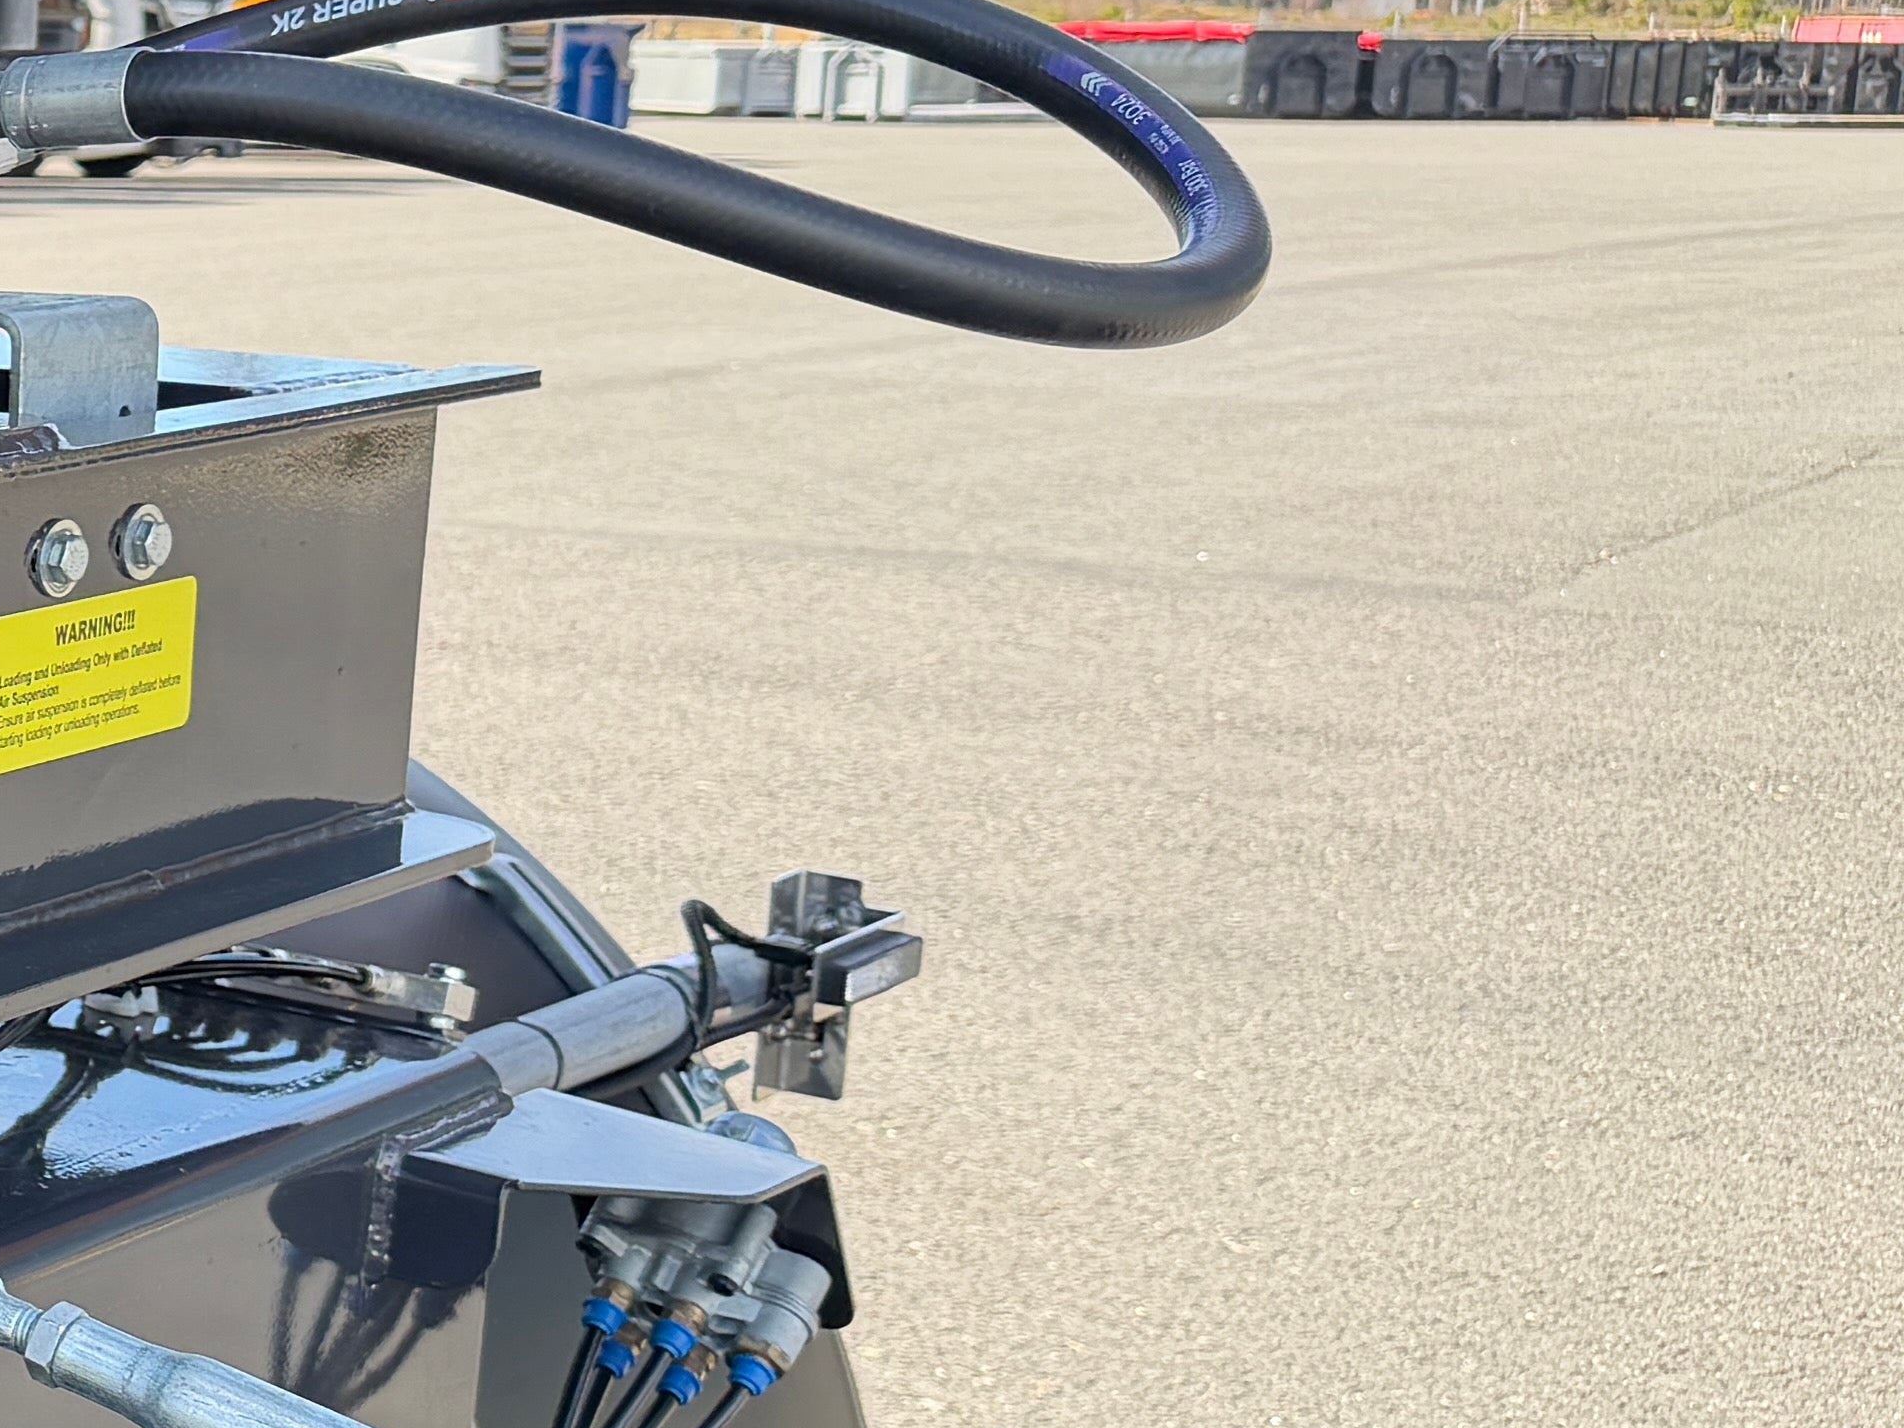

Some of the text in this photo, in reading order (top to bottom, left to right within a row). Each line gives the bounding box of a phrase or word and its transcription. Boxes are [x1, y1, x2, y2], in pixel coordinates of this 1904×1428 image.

[266, 4, 309, 36] 2K
[55, 609, 136, 646] WARNING!!!
[34, 665, 49, 681] and
[51, 657, 91, 677] Unloading
[93, 652, 112, 668] Only
[113, 647, 130, 662] with
[131, 638, 163, 658] Deflated
[12, 684, 60, 706] Suspension
[25, 710, 35, 723] air
[37, 696, 79, 722] suspension
[88, 686, 127, 708] completely
[128, 679, 159, 698] deflated
[159, 673, 182, 690] before
[26, 723, 53, 742] loading
[63, 712, 101, 733] unloading
